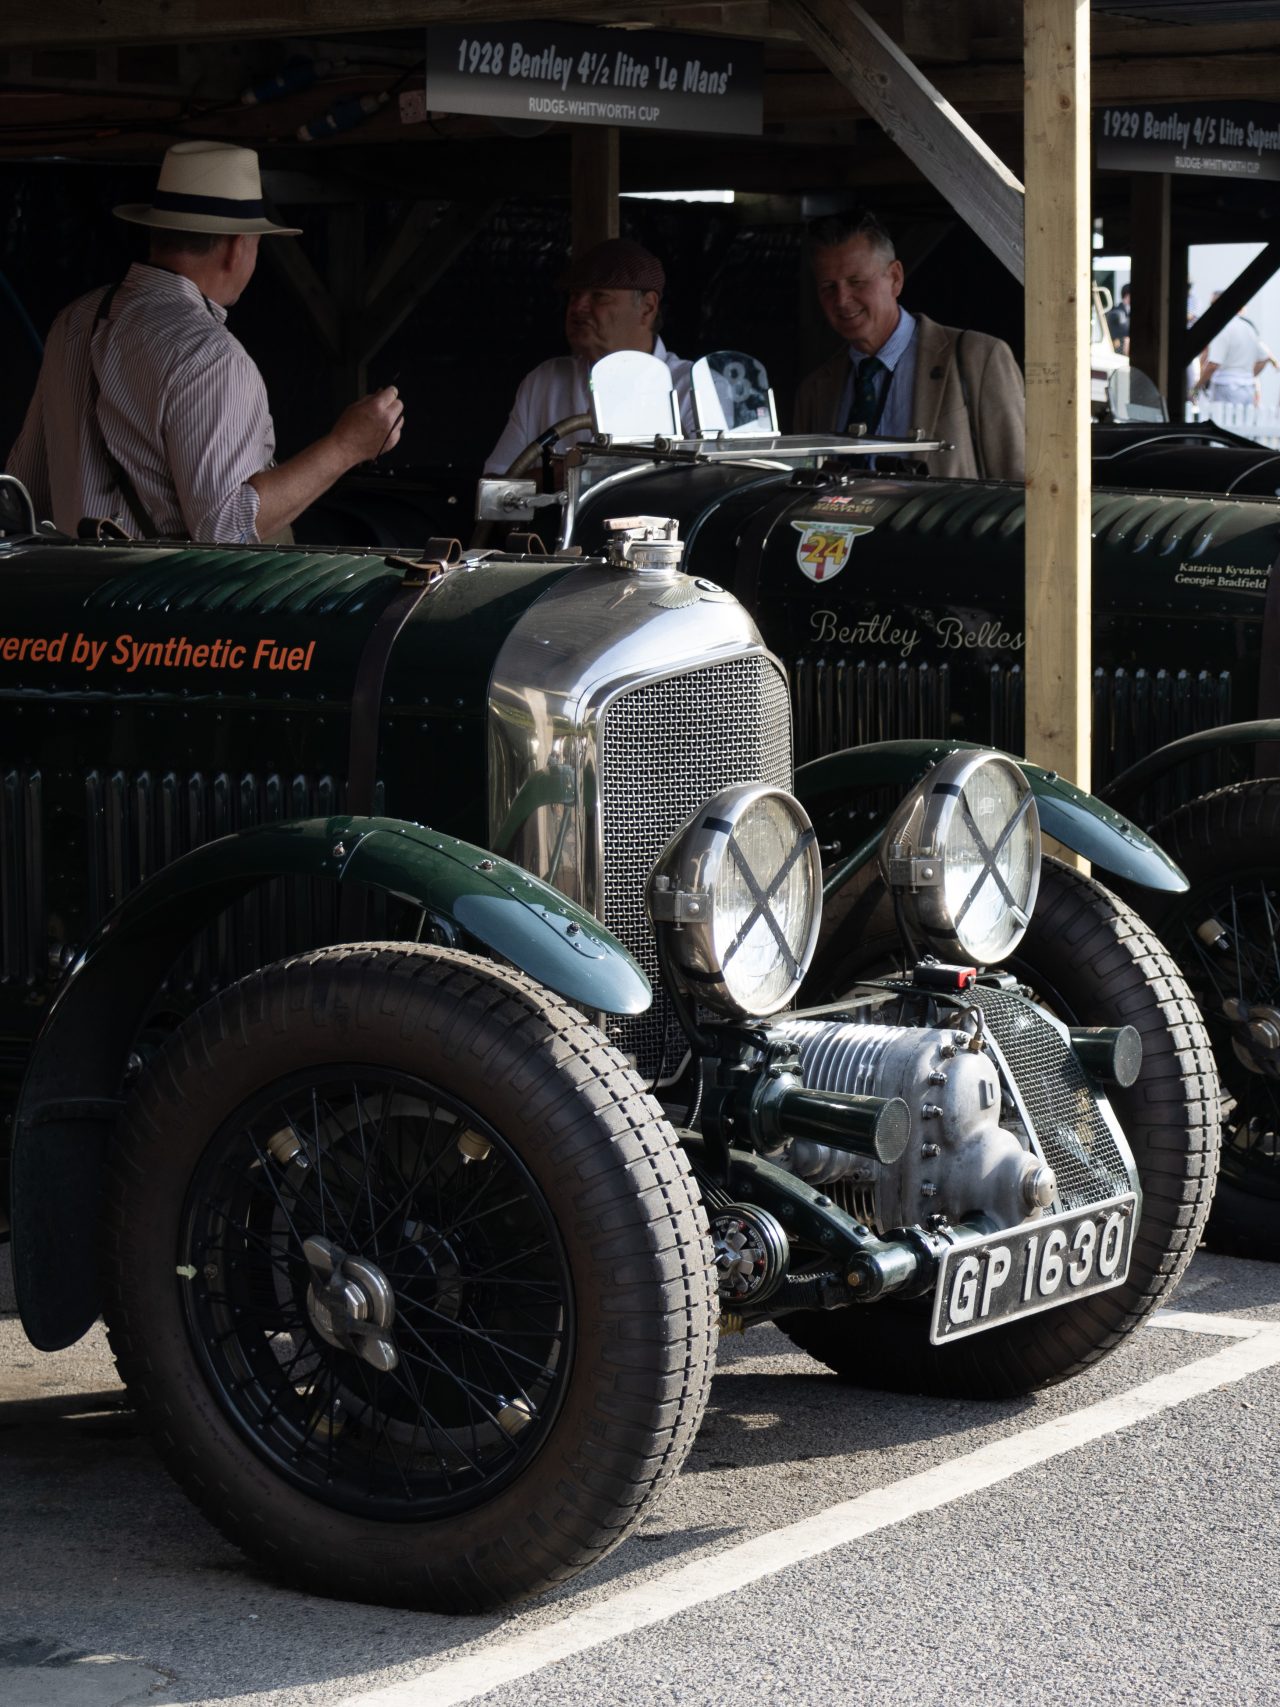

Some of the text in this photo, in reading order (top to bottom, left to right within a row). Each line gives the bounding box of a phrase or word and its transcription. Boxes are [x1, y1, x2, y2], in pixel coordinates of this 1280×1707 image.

[458, 39, 504, 74] 1928
[508, 42, 573, 91] Bentley
[613, 51, 648, 88] litre
[655, 56, 677, 91] 'Le
[682, 59, 732, 95] Mans'
[529, 97, 660, 121] RUDGE-WHITWORTH CUP
[1103, 110, 1140, 139] 1929
[1143, 111, 1190, 150] Bentley
[1193, 116, 1216, 145] 4/5
[1220, 118, 1244, 147] Litre
[802, 535, 846, 565] 24
[1174, 573, 1267, 590] Georgie Bradfield
[0, 632, 316, 673] ered by Synthetic Fuel
[810, 609, 1026, 657] Bentley Belles
[949, 1211, 1125, 1324] GP 1630
